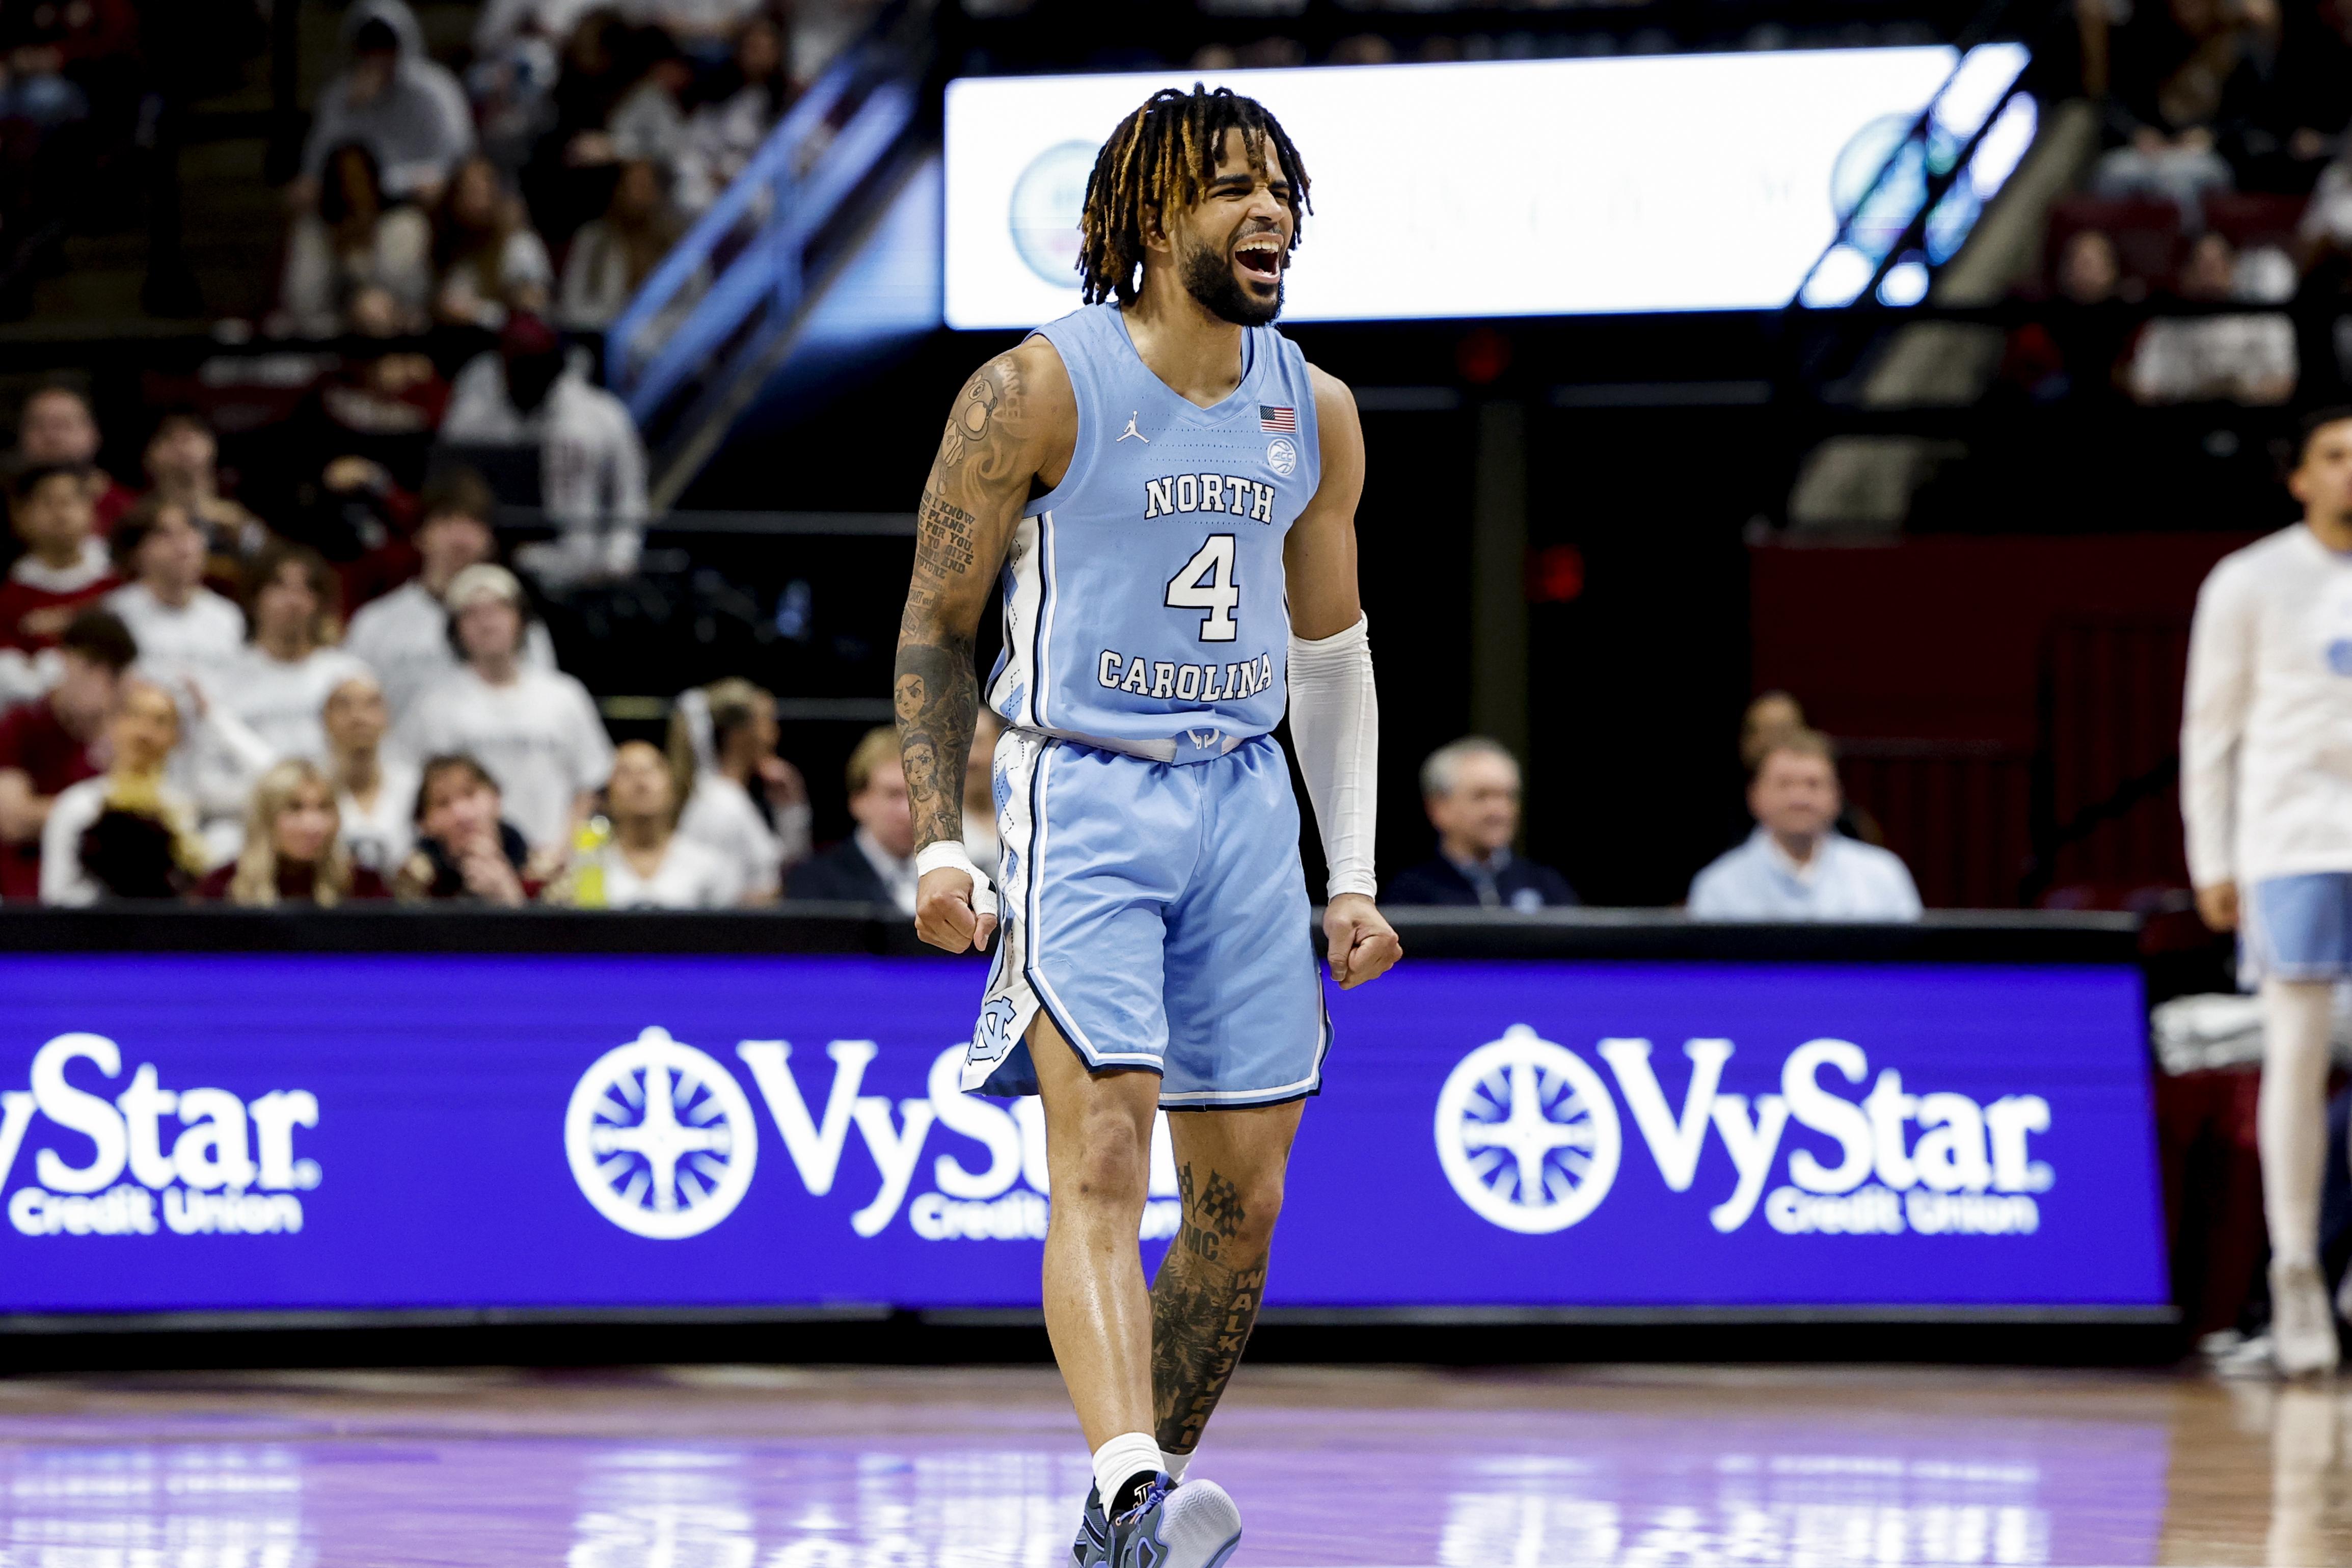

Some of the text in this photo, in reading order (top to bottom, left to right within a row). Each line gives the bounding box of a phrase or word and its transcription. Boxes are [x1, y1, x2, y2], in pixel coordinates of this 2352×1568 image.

[928, 509, 965, 534] PLANS
[932, 497, 938, 508] I
[939, 501, 976, 525] KNOW
[1144, 473, 1275, 525] NORTH
[925, 520, 946, 539] FOR
[928, 534, 940, 549] TO
[941, 555, 965, 574] AND
[1164, 533, 1240, 642] 4
[1098, 649, 1273, 702] CAROLINA
[1596, 1038, 2052, 1233] VyStar
[8, 1184, 304, 1236] Credit Union
[1764, 1185, 2039, 1234] Credit Union
